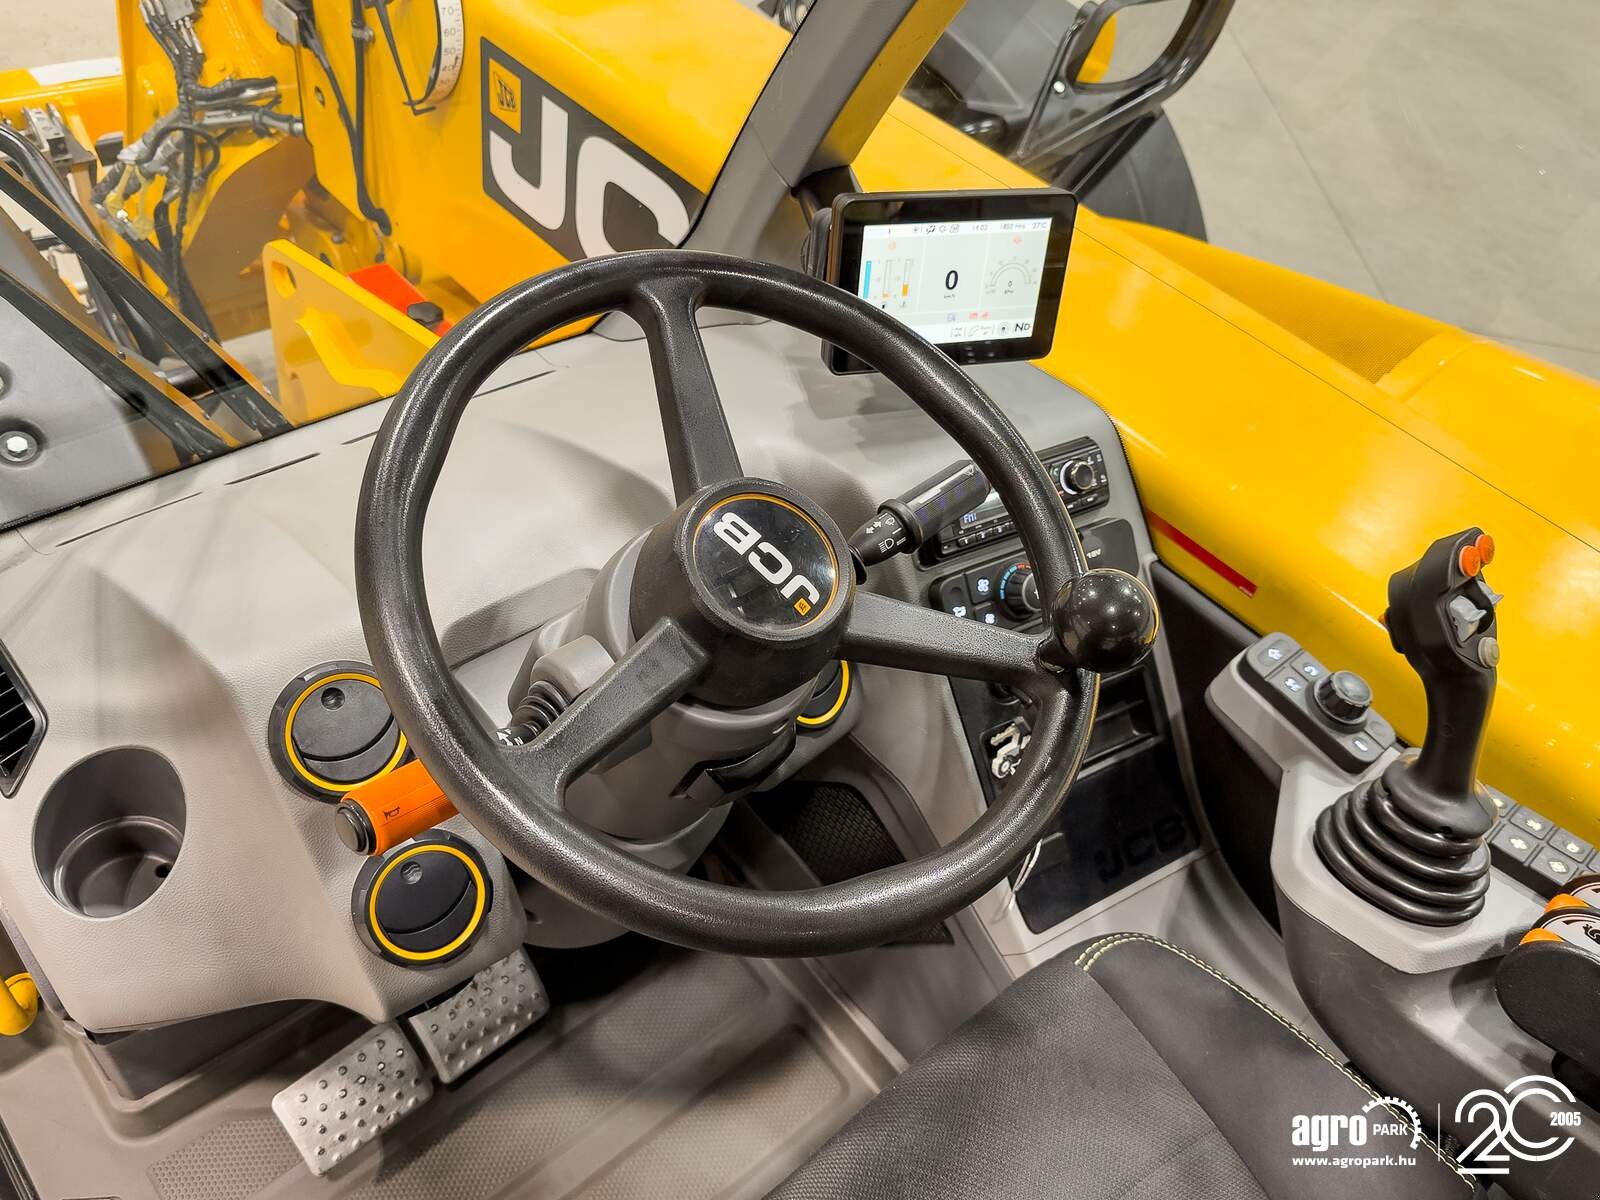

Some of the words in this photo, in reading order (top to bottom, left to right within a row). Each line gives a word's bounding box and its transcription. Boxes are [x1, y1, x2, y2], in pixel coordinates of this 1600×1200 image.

[441, 7, 455, 16] 70
[444, 27, 457, 38] 60
[443, 47, 457, 56] 50
[945, 270, 959, 290] 0
[713, 512, 820, 605] JCB
[1094, 815, 1186, 883] JCB
